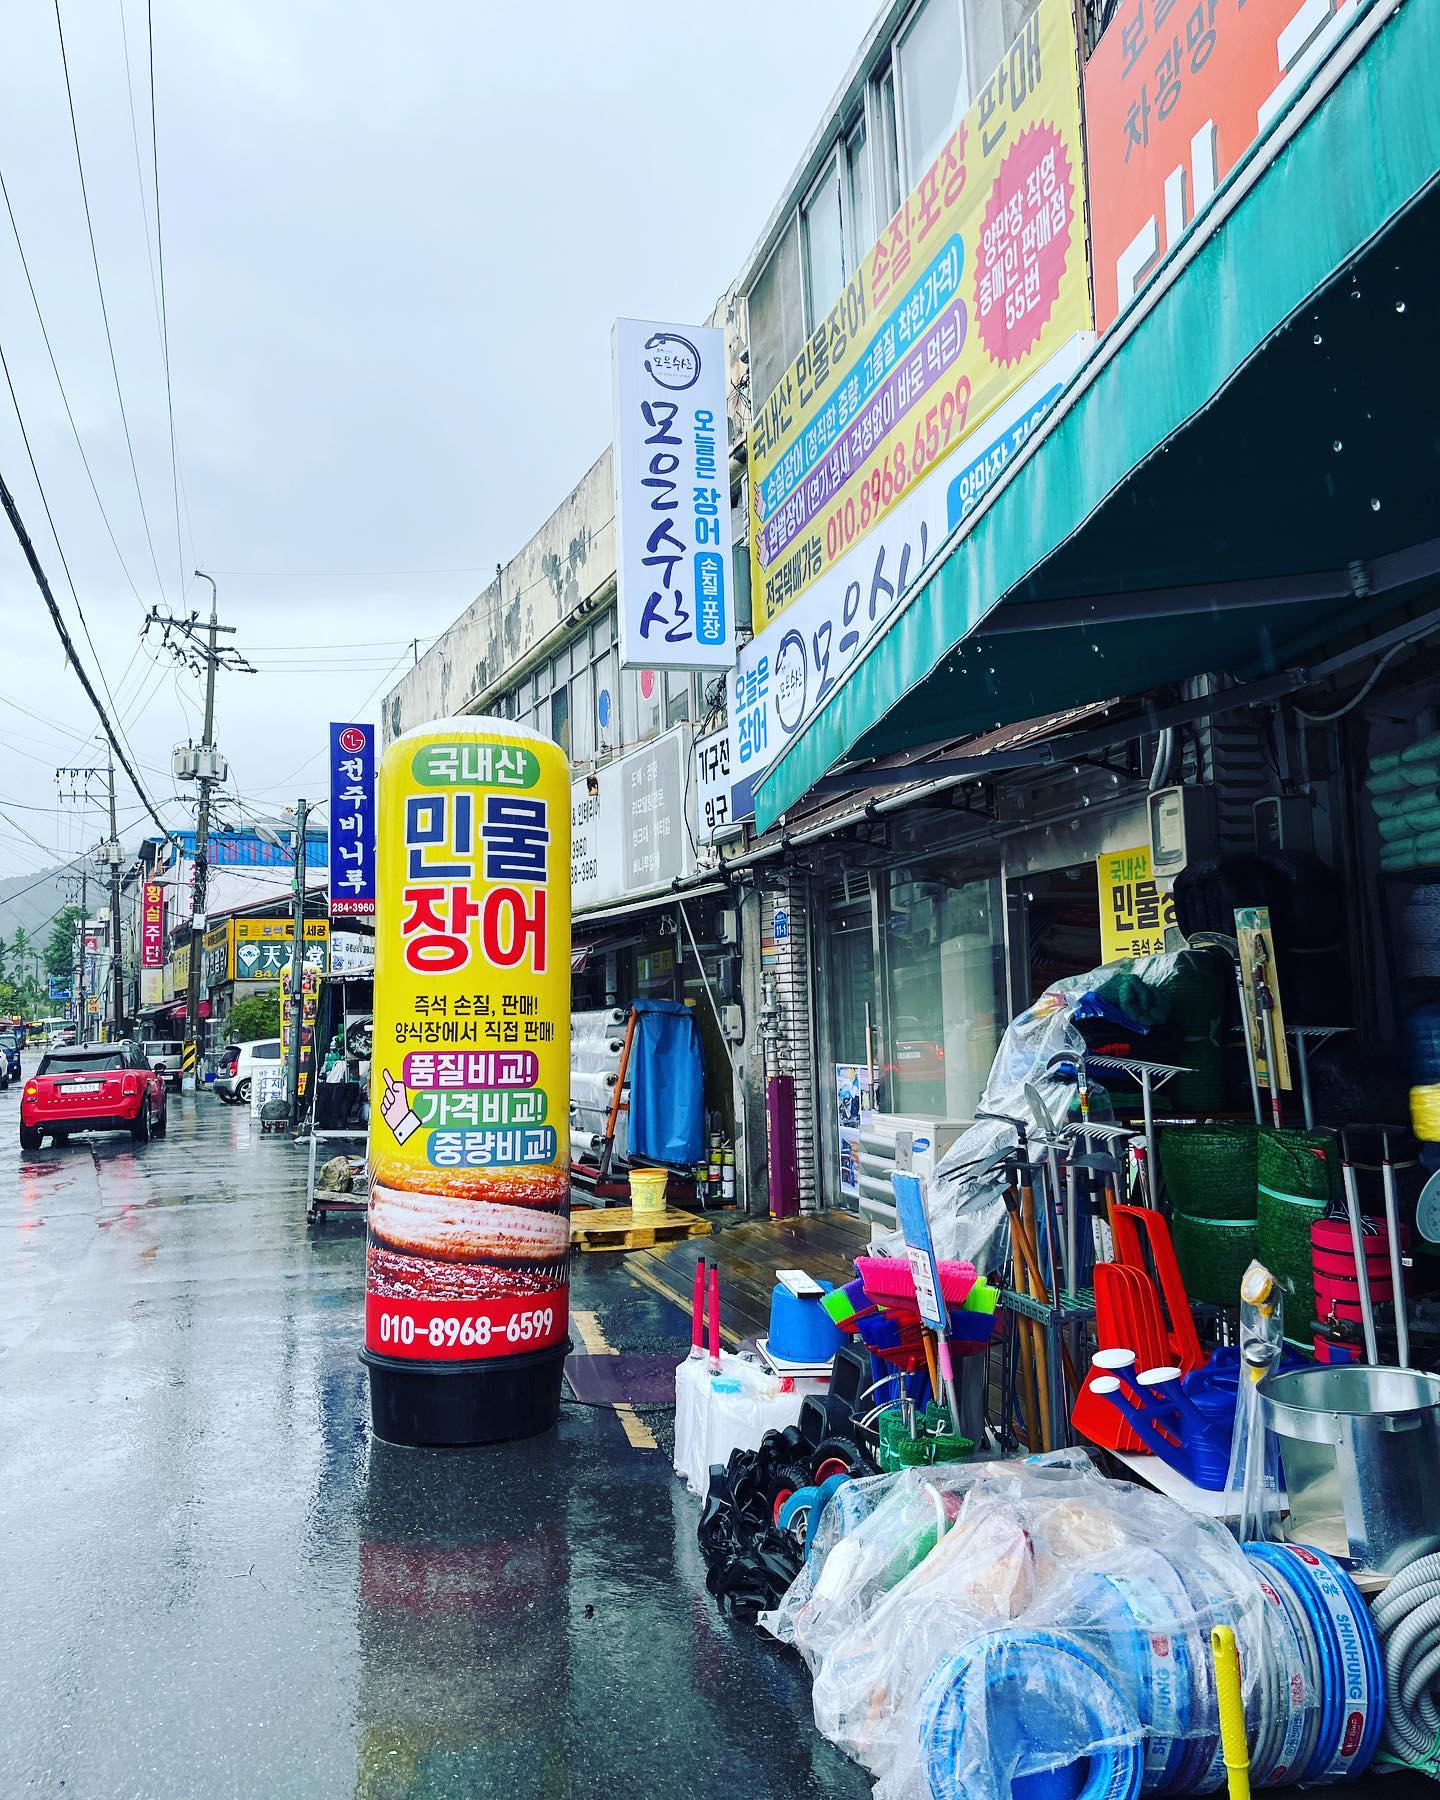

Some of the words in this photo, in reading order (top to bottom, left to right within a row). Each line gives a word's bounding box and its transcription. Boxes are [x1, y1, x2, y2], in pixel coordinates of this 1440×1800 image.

[753, 375, 792, 460] 국내산
[796, 268, 866, 409] 민물장어
[977, 11, 1040, 158] 판매
[983, 189, 1023, 267] 양만장
[1026, 146, 1056, 208] 직영
[980, 240, 1019, 317] 중매인
[1021, 183, 1066, 271] 판매점
[1005, 262, 1040, 330] 55번
[767, 438, 804, 512] 손질장어
[805, 403, 836, 467] (정직한
[864, 323, 896, 396] 고품질
[851, 384, 895, 460] 걱정없이
[898, 351, 925, 411] 바로
[927, 309, 961, 373] 먹는)
[694, 409, 716, 480] 오늘은
[826, 374, 971, 562] 010.8968.6599
[640, 400, 693, 643] 모은수산
[693, 487, 722, 546] 장어
[735, 655, 770, 715] 오늘은
[427, 747, 528, 785] 국내산
[738, 701, 768, 764] 장어
[338, 757, 368, 895] 전주비니루
[405, 794, 550, 882] 민물
[1111, 855, 1147, 882] 국내산
[401, 884, 548, 974] 장어
[394, 1020, 478, 1044] 양식장에서
[485, 1020, 519, 1043] 직접
[523, 1020, 555, 1043] 판매!
[414, 995, 448, 1017] 즉석
[453, 994, 496, 1019] 손질,
[501, 995, 539, 1017] 판매!
[408, 1052, 533, 1087] 품질비교!
[421, 1091, 543, 1126] 가격비교!
[432, 1129, 553, 1163] 중량비교!
[379, 1307, 554, 1347] 010-8968-6599
[1336, 1613, 1365, 1700] SHINHUNG
